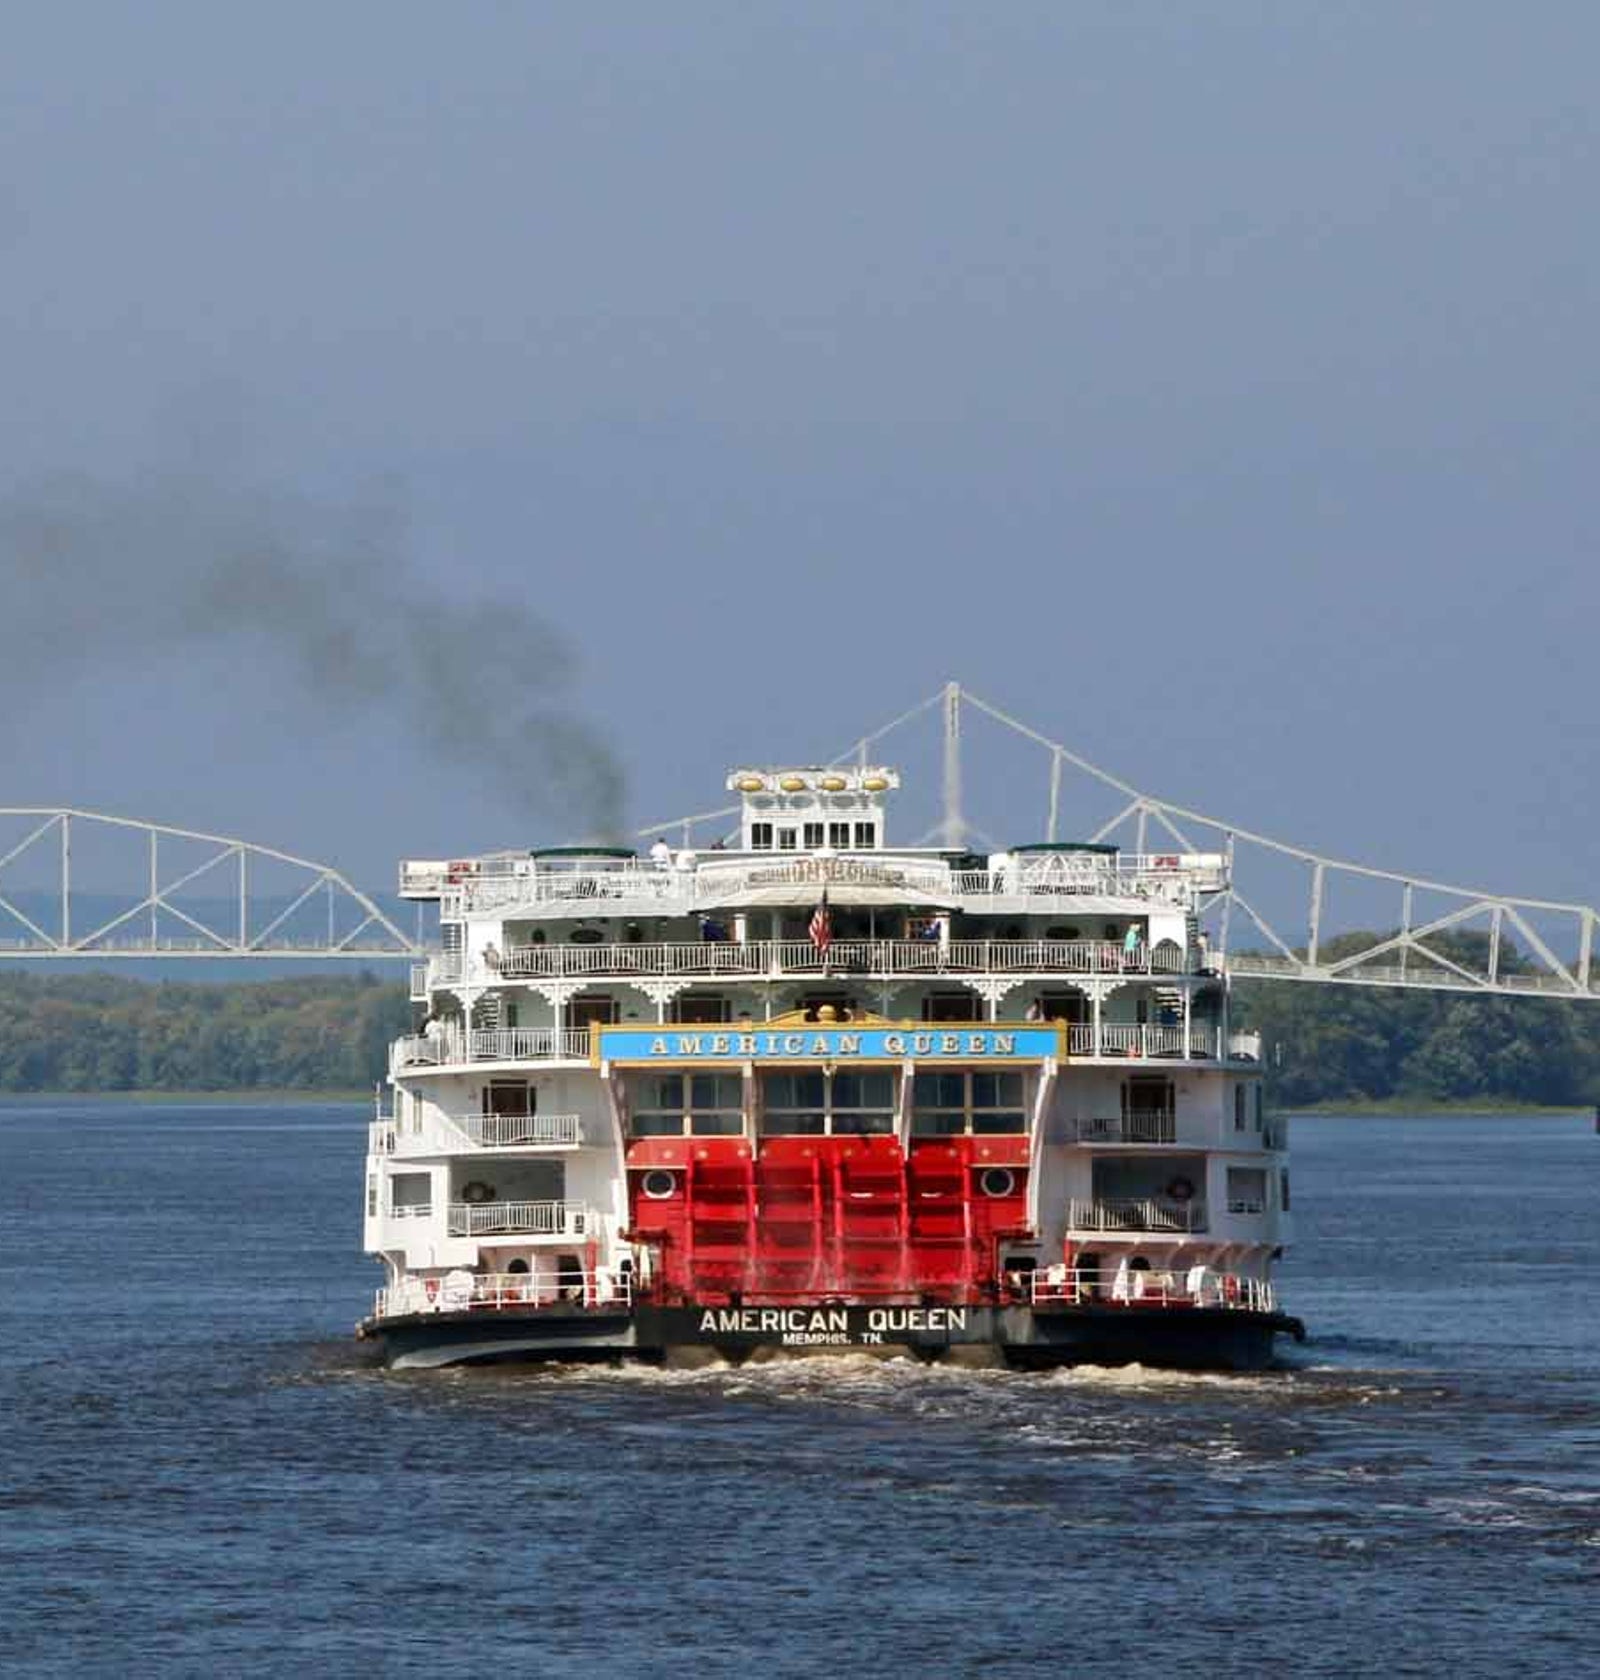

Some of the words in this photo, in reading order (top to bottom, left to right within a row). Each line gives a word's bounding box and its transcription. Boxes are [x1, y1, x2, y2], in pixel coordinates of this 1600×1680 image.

[650, 1034, 861, 1055] AMERICAN
[884, 1033, 1016, 1055] QUEEN
[699, 1308, 848, 1332] AMERICAN
[867, 1308, 967, 1332] QUEEN
